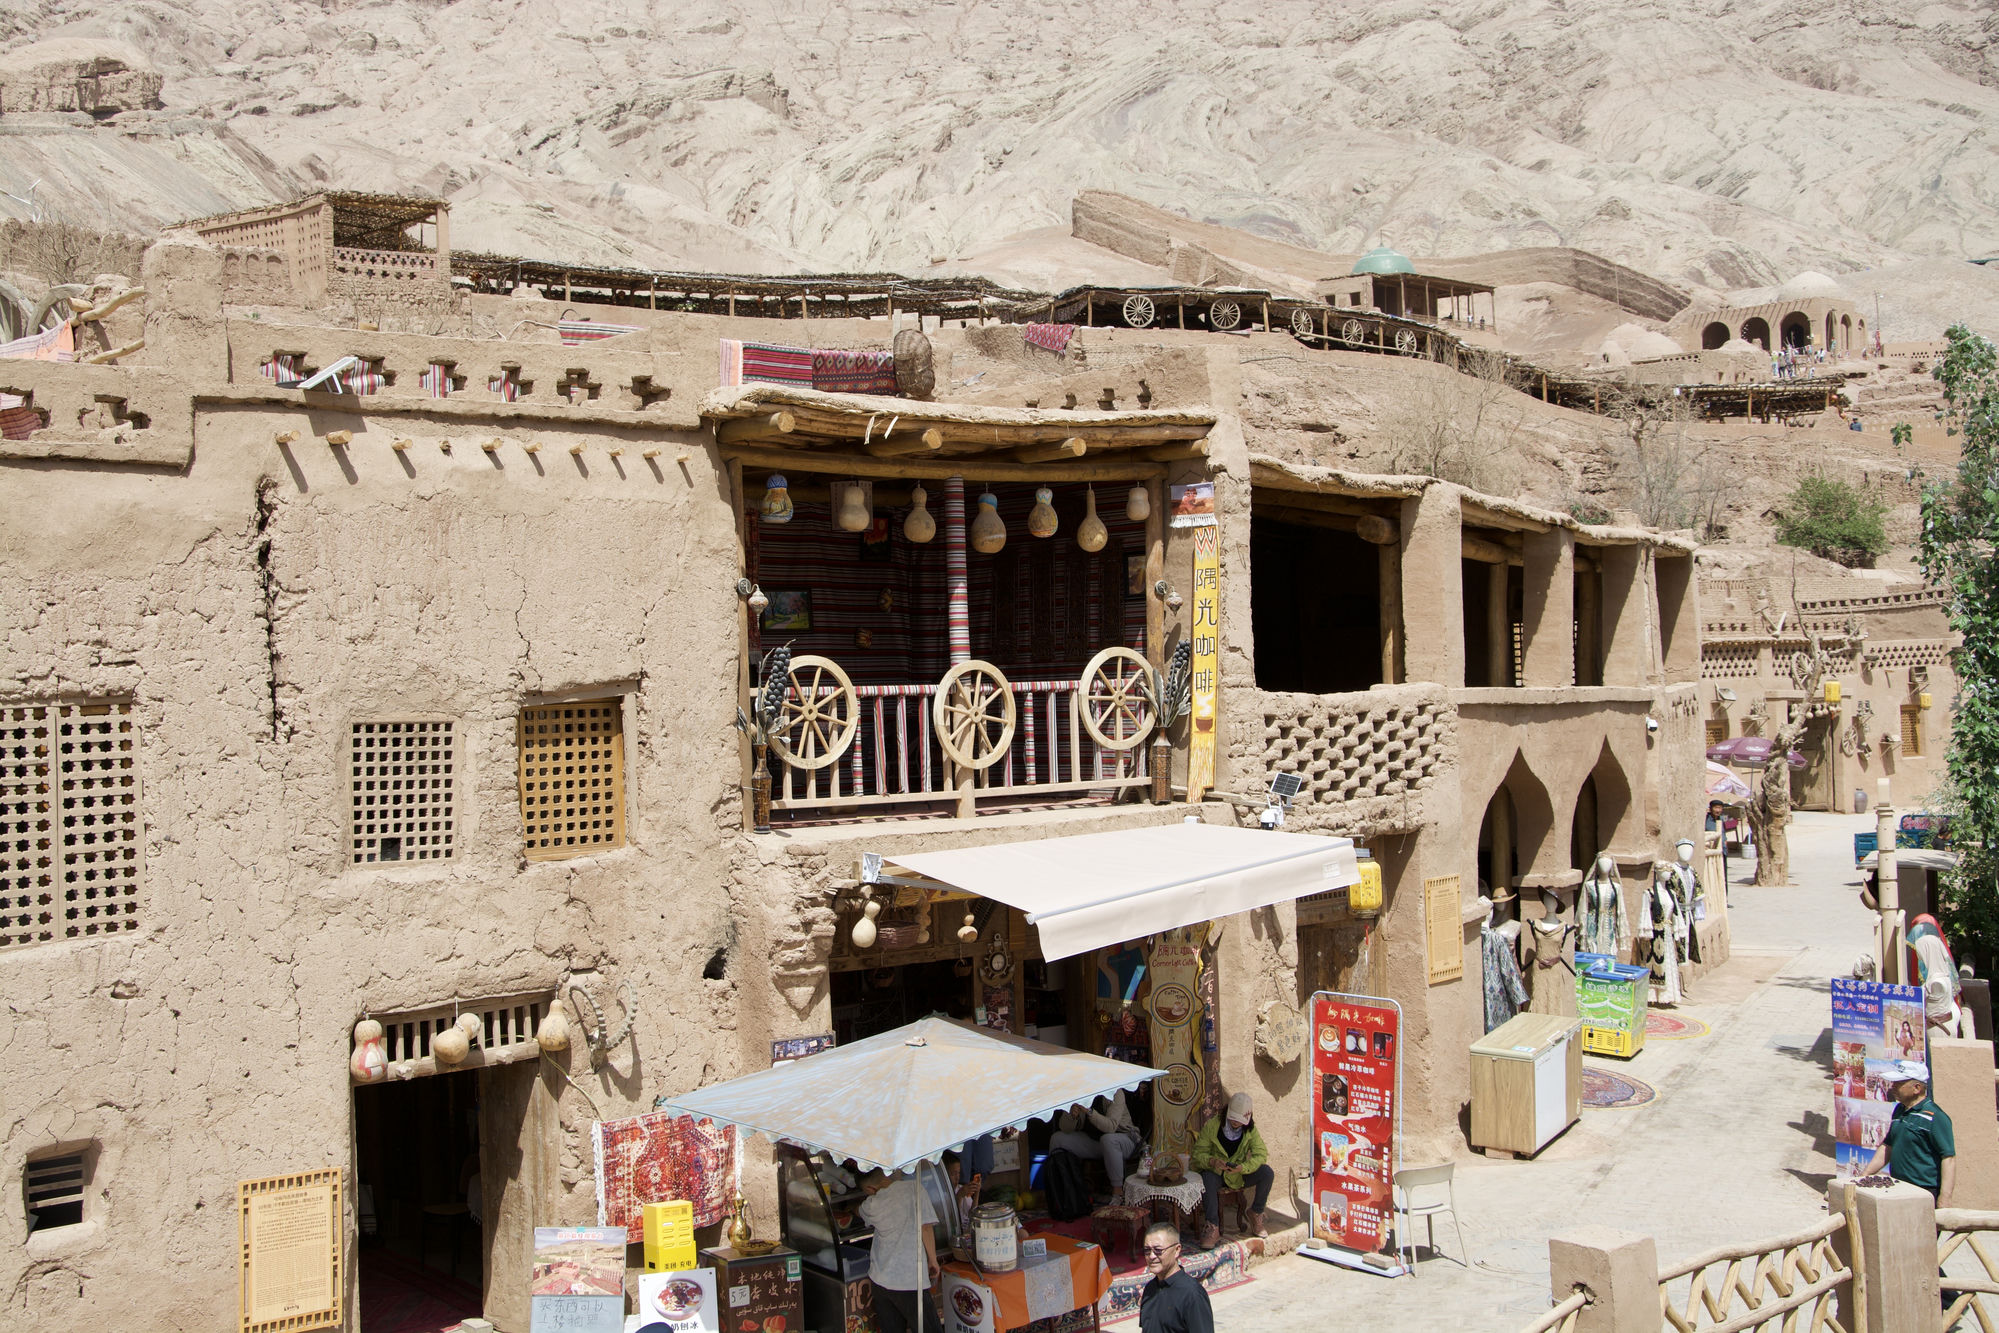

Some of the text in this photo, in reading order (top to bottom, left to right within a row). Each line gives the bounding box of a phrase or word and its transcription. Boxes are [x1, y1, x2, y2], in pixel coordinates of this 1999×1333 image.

[1195, 568, 1217, 693] 隅光咖啡
[1833, 1000, 1879, 1014] 私人定制
[1348, 1122, 1367, 1133] 气泡水
[1341, 1182, 1372, 1194] 水果茶系列
[731, 1287, 747, 1303] 5元
[538, 1297, 605, 1313] 买东西可以
[670, 1321, 699, 1332] 奶刨冰
